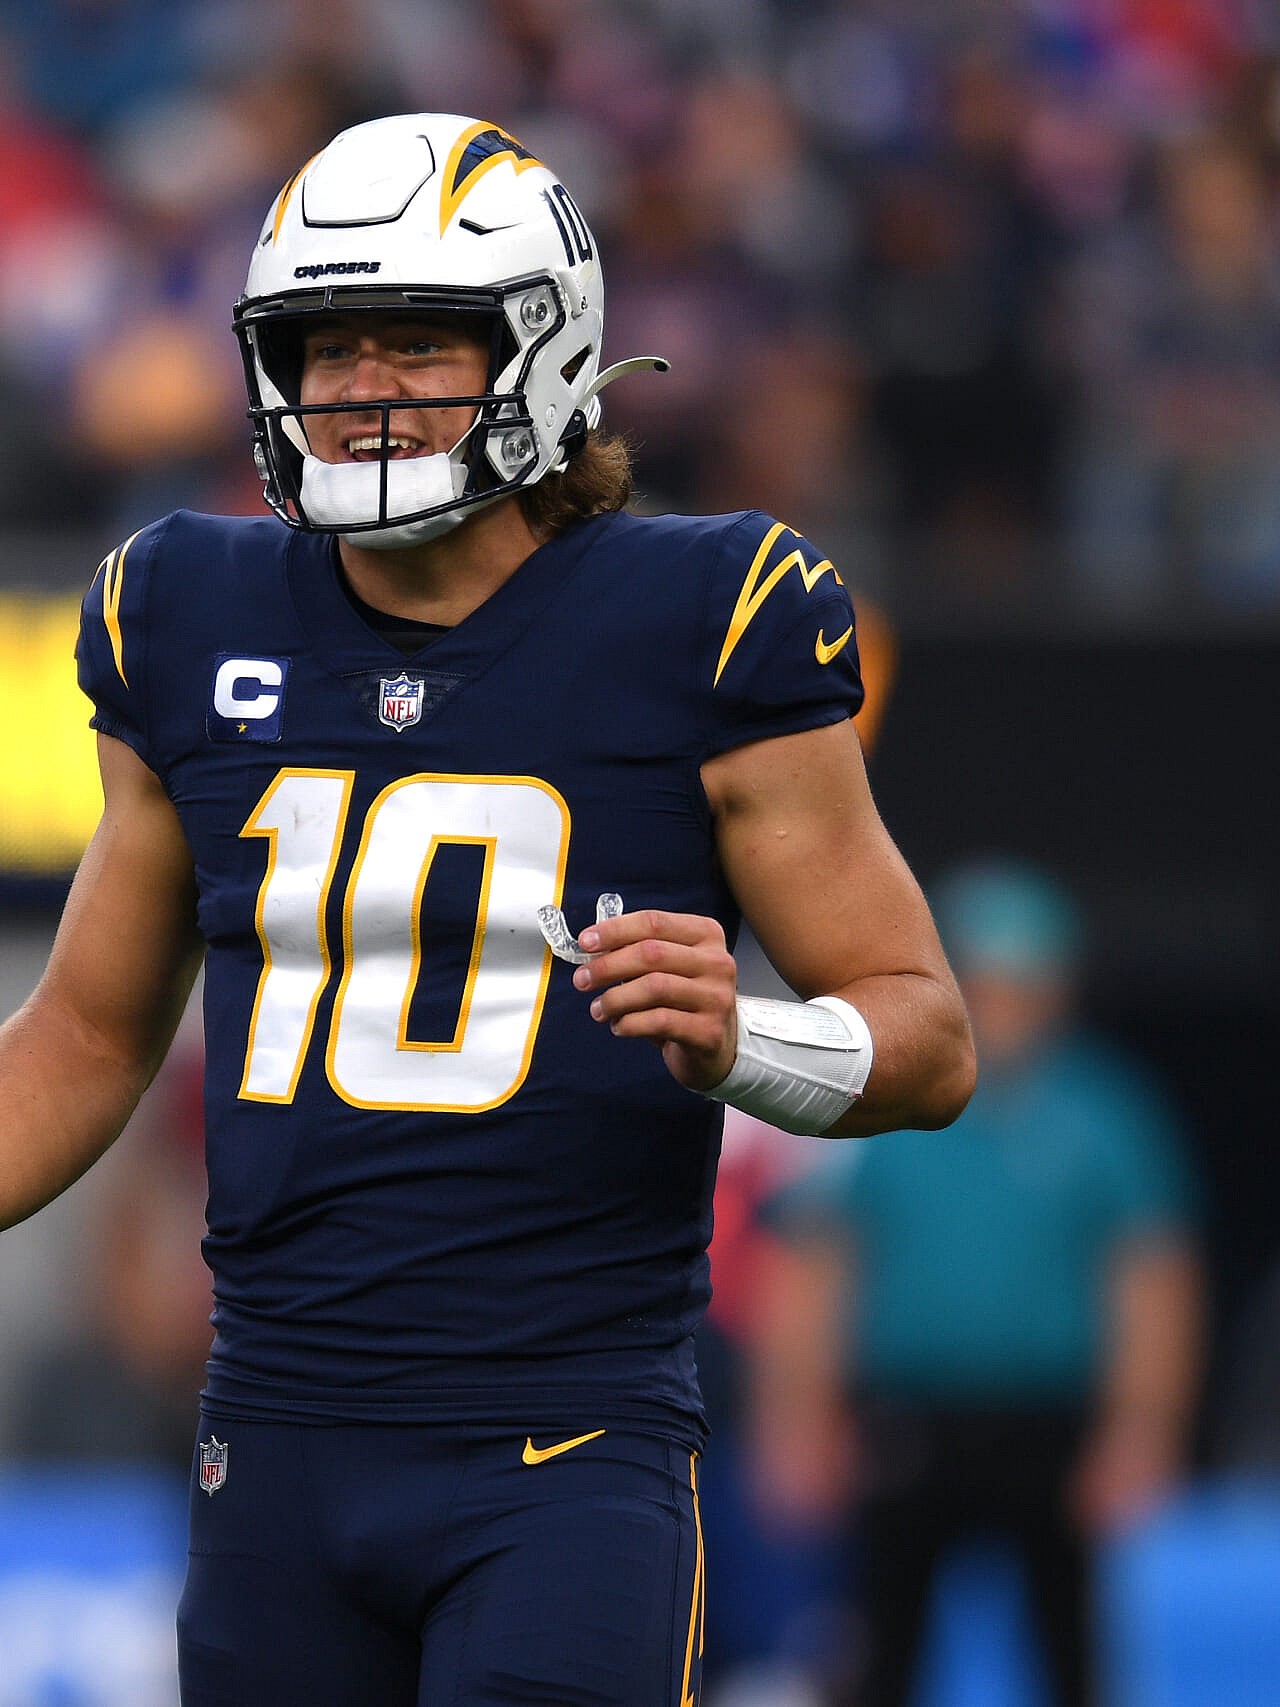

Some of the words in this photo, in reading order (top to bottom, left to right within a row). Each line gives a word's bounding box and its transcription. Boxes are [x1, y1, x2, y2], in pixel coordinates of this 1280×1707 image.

[539, 183, 593, 267] 10
[293, 261, 382, 280] CHARGERS
[213, 659, 282, 720] C
[385, 698, 415, 721] NFL
[237, 767, 572, 1114] 10
[203, 1464, 222, 1485] NFL
